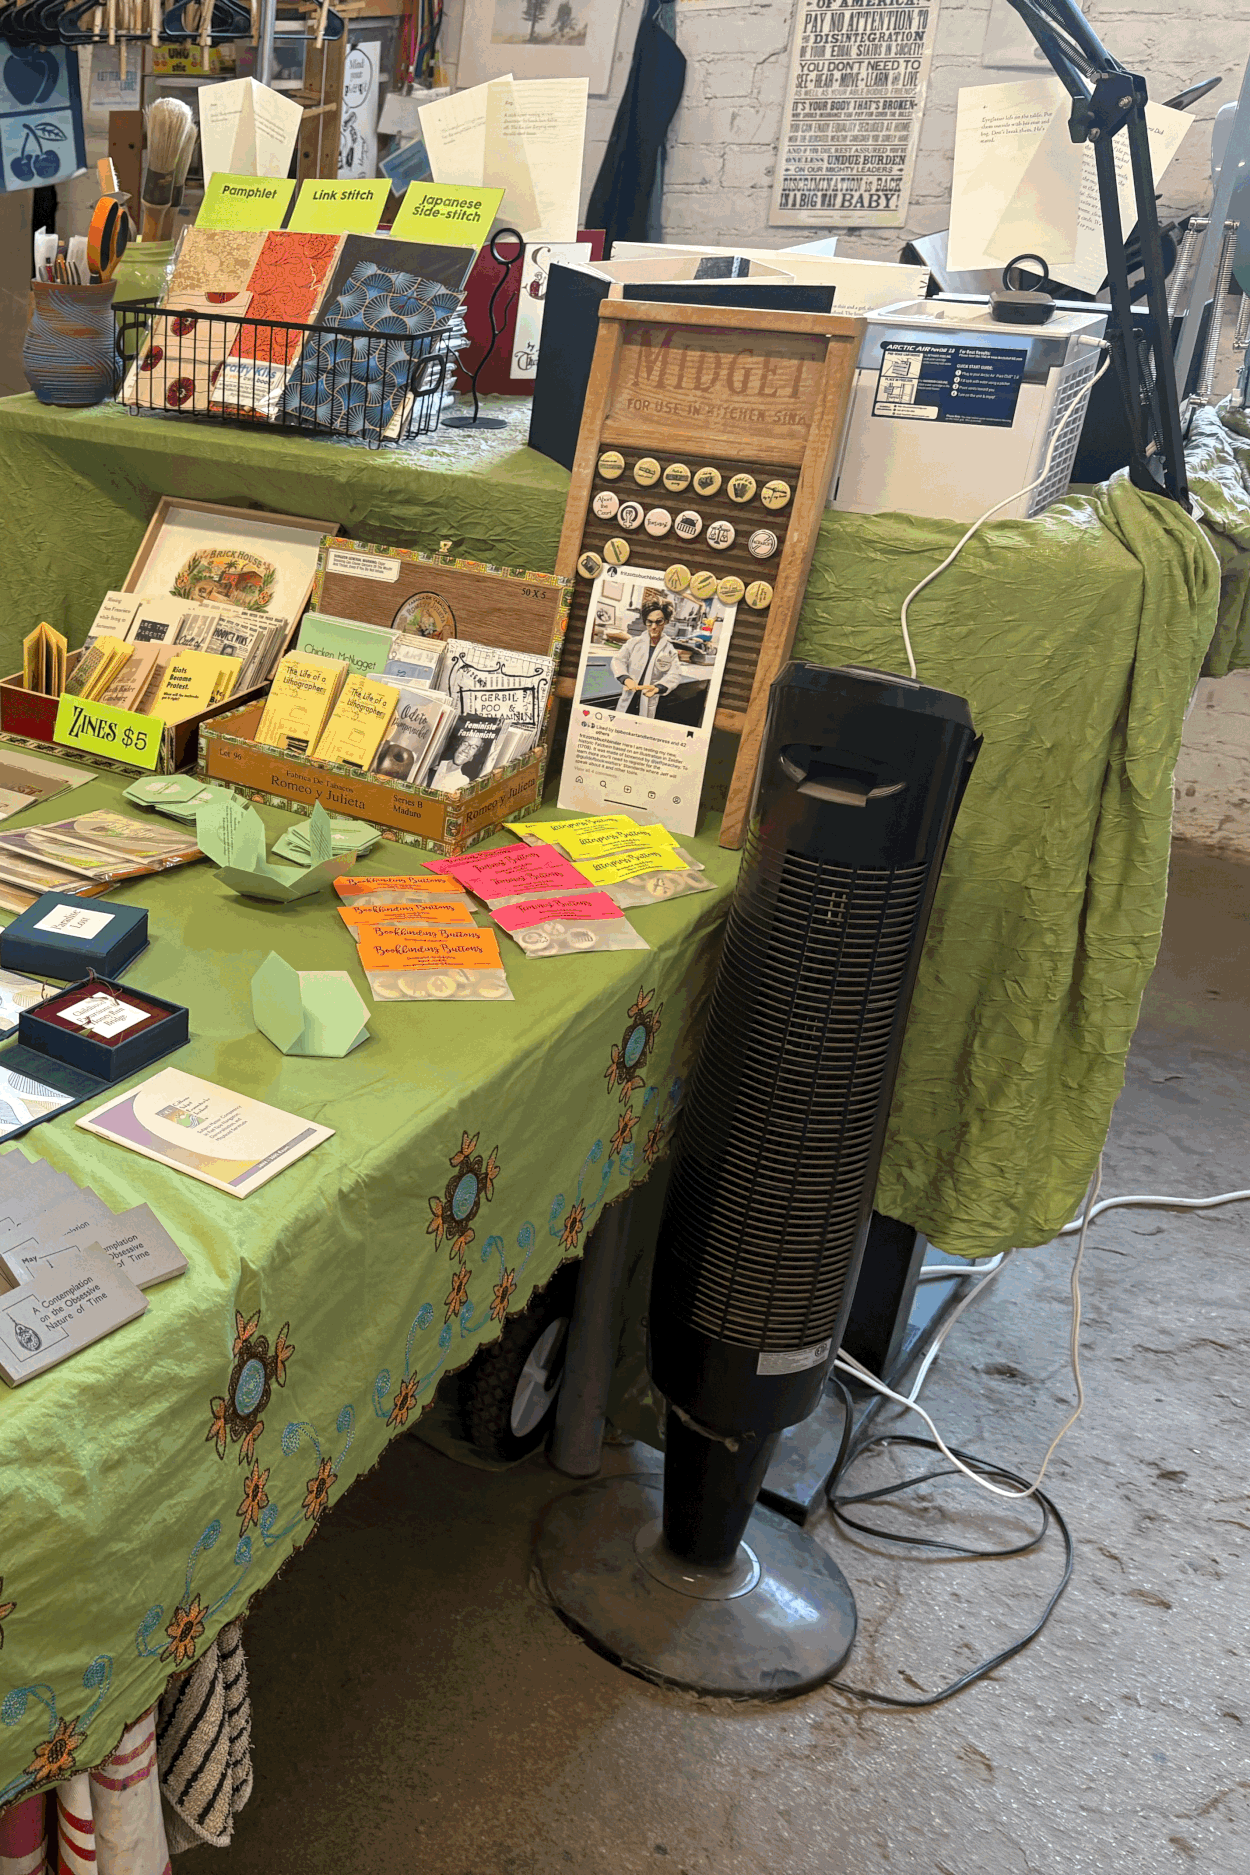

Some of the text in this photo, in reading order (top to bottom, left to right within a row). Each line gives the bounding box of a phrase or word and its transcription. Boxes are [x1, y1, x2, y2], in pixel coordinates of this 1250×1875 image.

[803, 10, 928, 33] PAY NO ATTENTION TO
[813, 31, 926, 44] DISINTEGRATION
[800, 59, 921, 72] YOU DON'T NEED TO
[814, 73, 833, 88] HEAR
[839, 72, 859, 88] MOVE
[865, 72, 889, 87] LEARN
[903, 72, 919, 87] LIVE
[792, 102, 806, 112] IT'S
[809, 101, 828, 111] YOUR
[830, 101, 850, 110] BODY
[853, 100, 880, 110] THAT'S
[827, 155, 861, 165] UNDUE
[862, 155, 906, 165] BURDEN
[782, 178, 863, 192] DISCRIMINATION
[876, 178, 903, 192] BACK
[222, 185, 278, 201] Pamphlet
[313, 190, 338, 201] Link
[421, 194, 482, 210] Japanese
[780, 194, 789, 208] IN
[800, 194, 818, 208] BIG
[821, 194, 838, 208] WAY
[839, 193, 900, 209] BABY!
[412, 205, 481, 223] side-stitch
[630, 329, 805, 398] MIDGET
[627, 399, 650, 411] FOR
[655, 400, 679, 415] USE
[687, 403, 700, 415] IN
[210, 550, 263, 569] BRICK HOUSE
[522, 587, 531, 596] 50
[532, 589, 540, 598] X
[304, 643, 376, 671] Chicken McNugget
[172, 666, 188, 674] Riots
[287, 667, 297, 675] The
[300, 670, 311, 678] Life
[313, 673, 321, 681] of
[169, 674, 192, 683] Become
[166, 682, 190, 690] Protest.
[68, 705, 148, 751] ZINES $5
[465, 721, 497, 731] Feminista
[458, 730, 496, 739] Fashionista
[219, 748, 242, 761] Lot 96
[286, 770, 354, 794] Fabrica De Tabacos
[271, 775, 365, 810] Romeo y Julieta
[393, 795, 423, 808] Series B
[466, 777, 536, 823] Romeo y Julieta
[393, 805, 422, 819] Maduro
[373, 927, 480, 939] Bookbinding Buttons
[373, 944, 483, 956] Bookbinding Buttons
[21, 1254, 38, 1265] May
[32, 1276, 94, 1315] A Contemplation
[39, 1283, 101, 1323] on the Obsessive
[45, 1291, 108, 1332] Nature of Time
